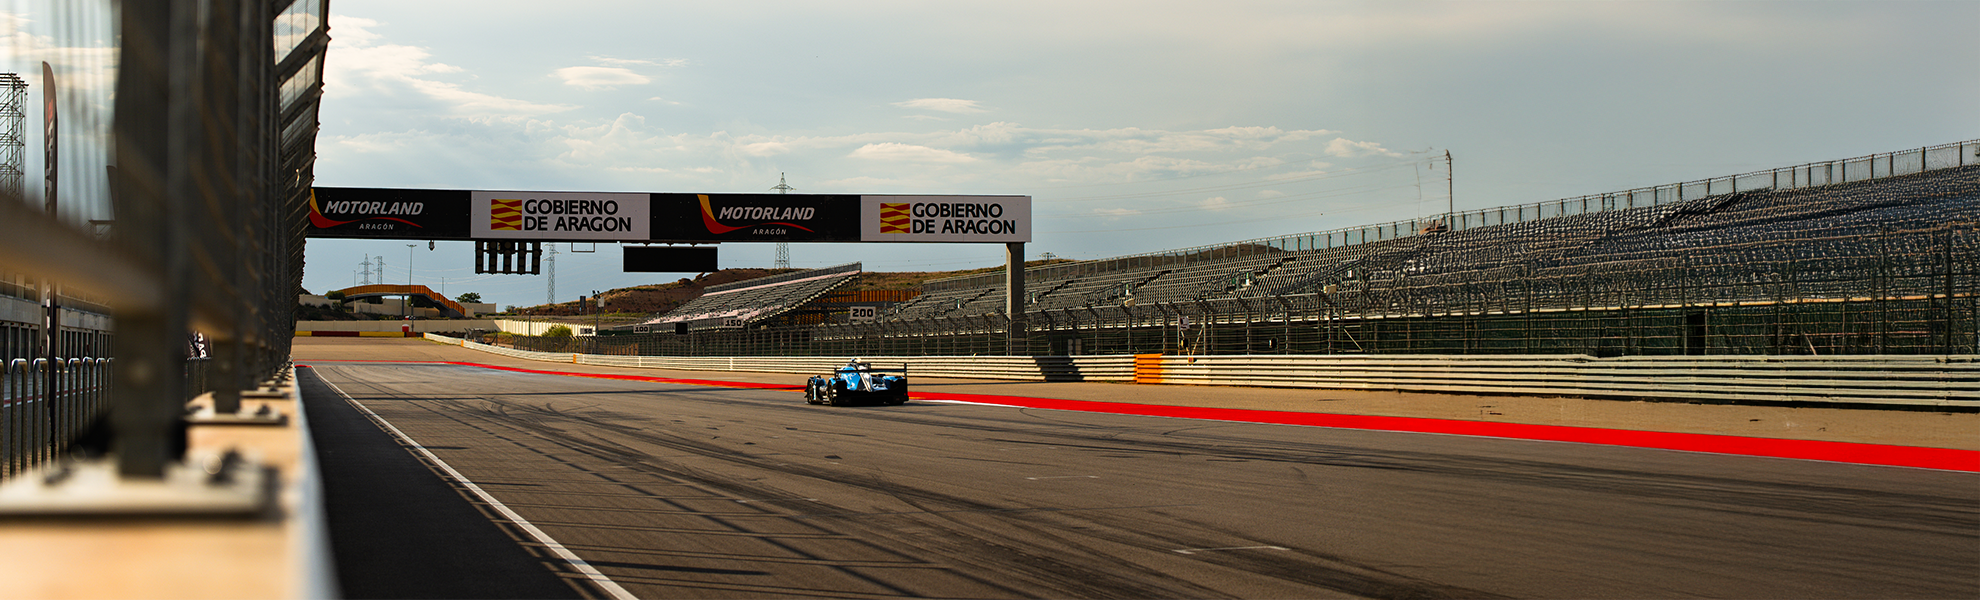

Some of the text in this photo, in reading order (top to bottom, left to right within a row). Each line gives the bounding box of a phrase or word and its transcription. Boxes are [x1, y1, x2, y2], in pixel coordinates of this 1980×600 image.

[324, 200, 424, 216] MOTORLAND
[524, 199, 619, 215] GOBIERNO
[719, 206, 815, 220] MOTORLAND
[912, 202, 1003, 218] GOBIERNO
[524, 216, 632, 232] DE ARAGON
[912, 219, 1016, 235] DE ARAGON
[852, 308, 874, 318] 200
[725, 319, 742, 327] 150
